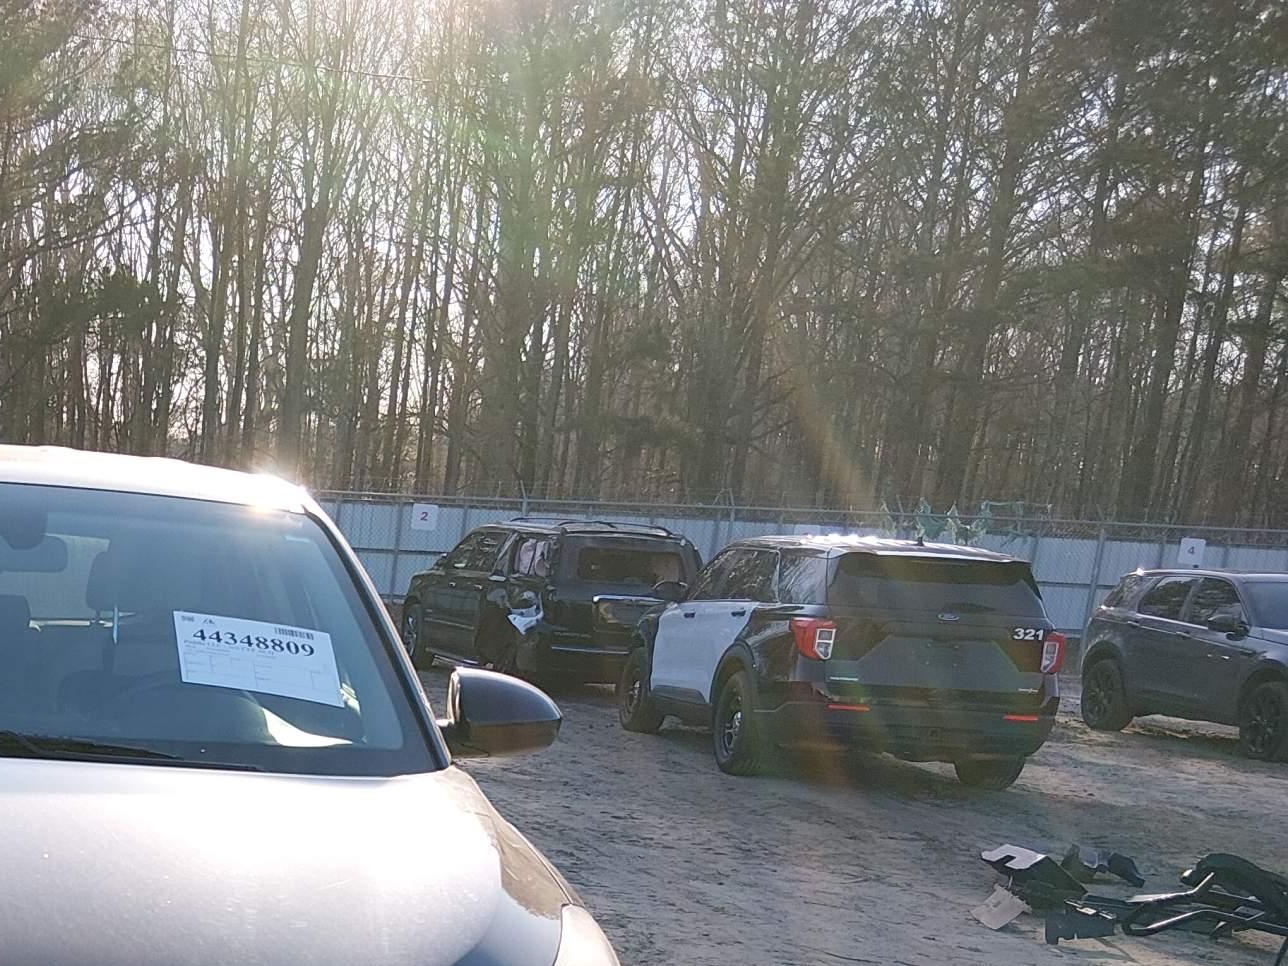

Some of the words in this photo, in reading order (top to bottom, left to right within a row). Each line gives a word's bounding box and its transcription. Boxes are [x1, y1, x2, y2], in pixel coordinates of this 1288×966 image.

[420, 511, 429, 521] 2
[1013, 628, 1044, 641] 321
[192, 628, 315, 657] 44348809
